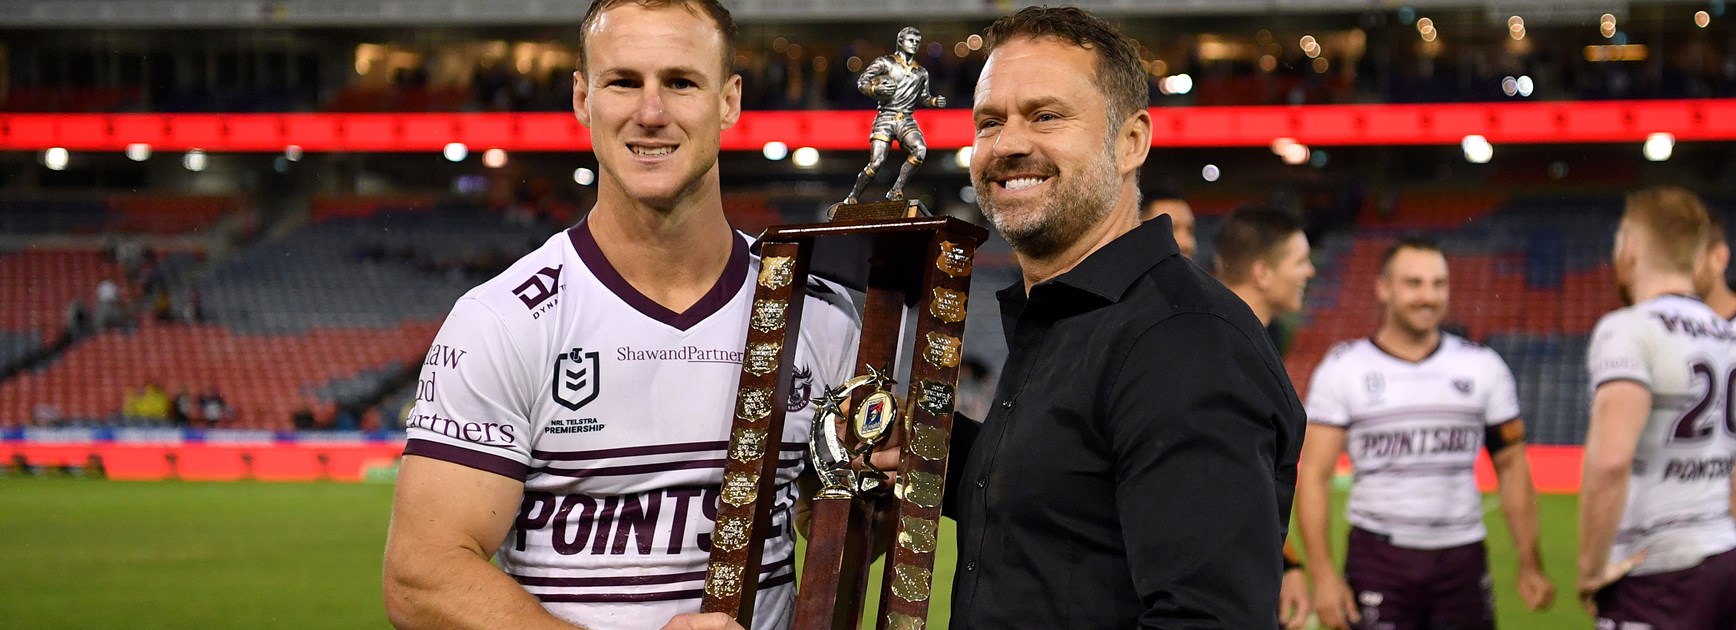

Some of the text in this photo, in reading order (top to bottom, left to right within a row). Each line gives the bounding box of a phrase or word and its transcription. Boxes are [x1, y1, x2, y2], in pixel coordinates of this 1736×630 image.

[617, 345, 744, 361] ShawandPartner
[407, 412, 515, 444] artners
[566, 417, 598, 426] TELSTRA
[544, 424, 605, 434] PREMIERSHIP
